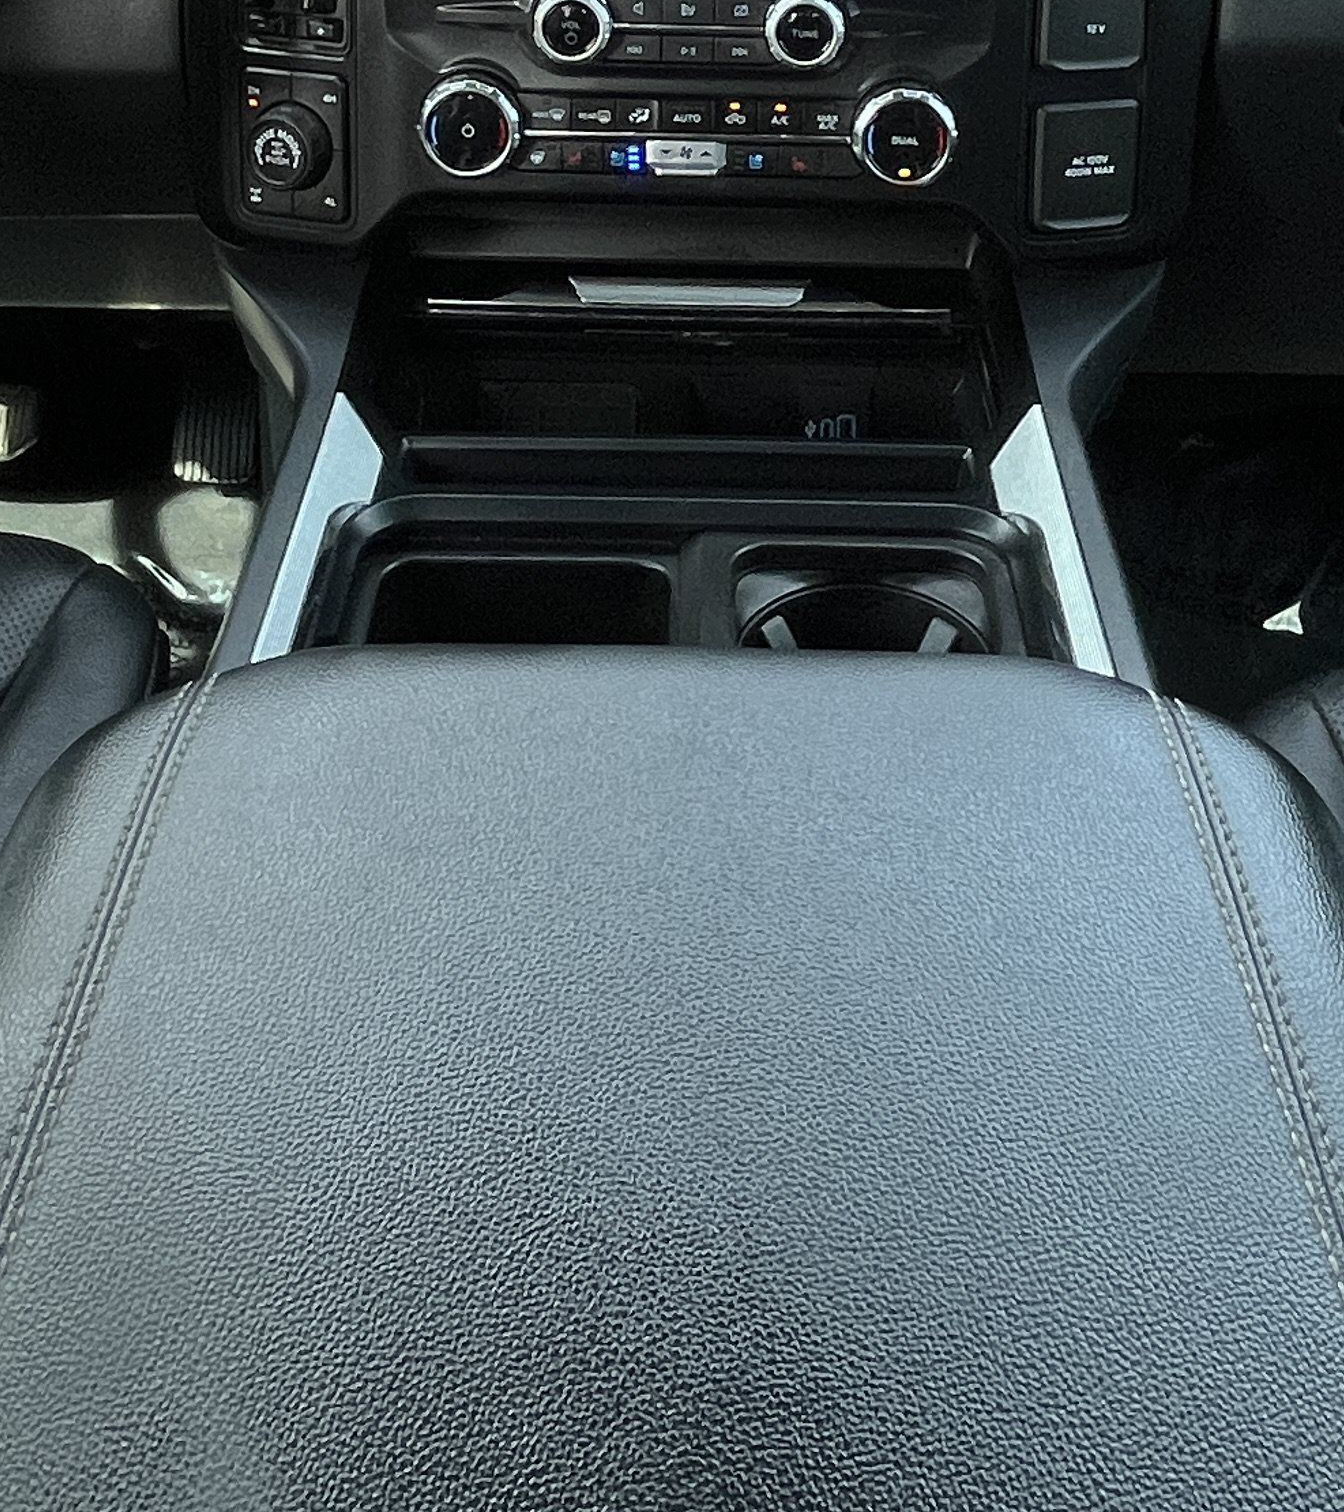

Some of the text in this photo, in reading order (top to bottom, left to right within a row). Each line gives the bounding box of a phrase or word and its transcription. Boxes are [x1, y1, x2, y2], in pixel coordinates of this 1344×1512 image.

[672, 112, 702, 124] AUTO
[770, 113, 790, 126] A/C
[891, 134, 919, 147] DUAL
